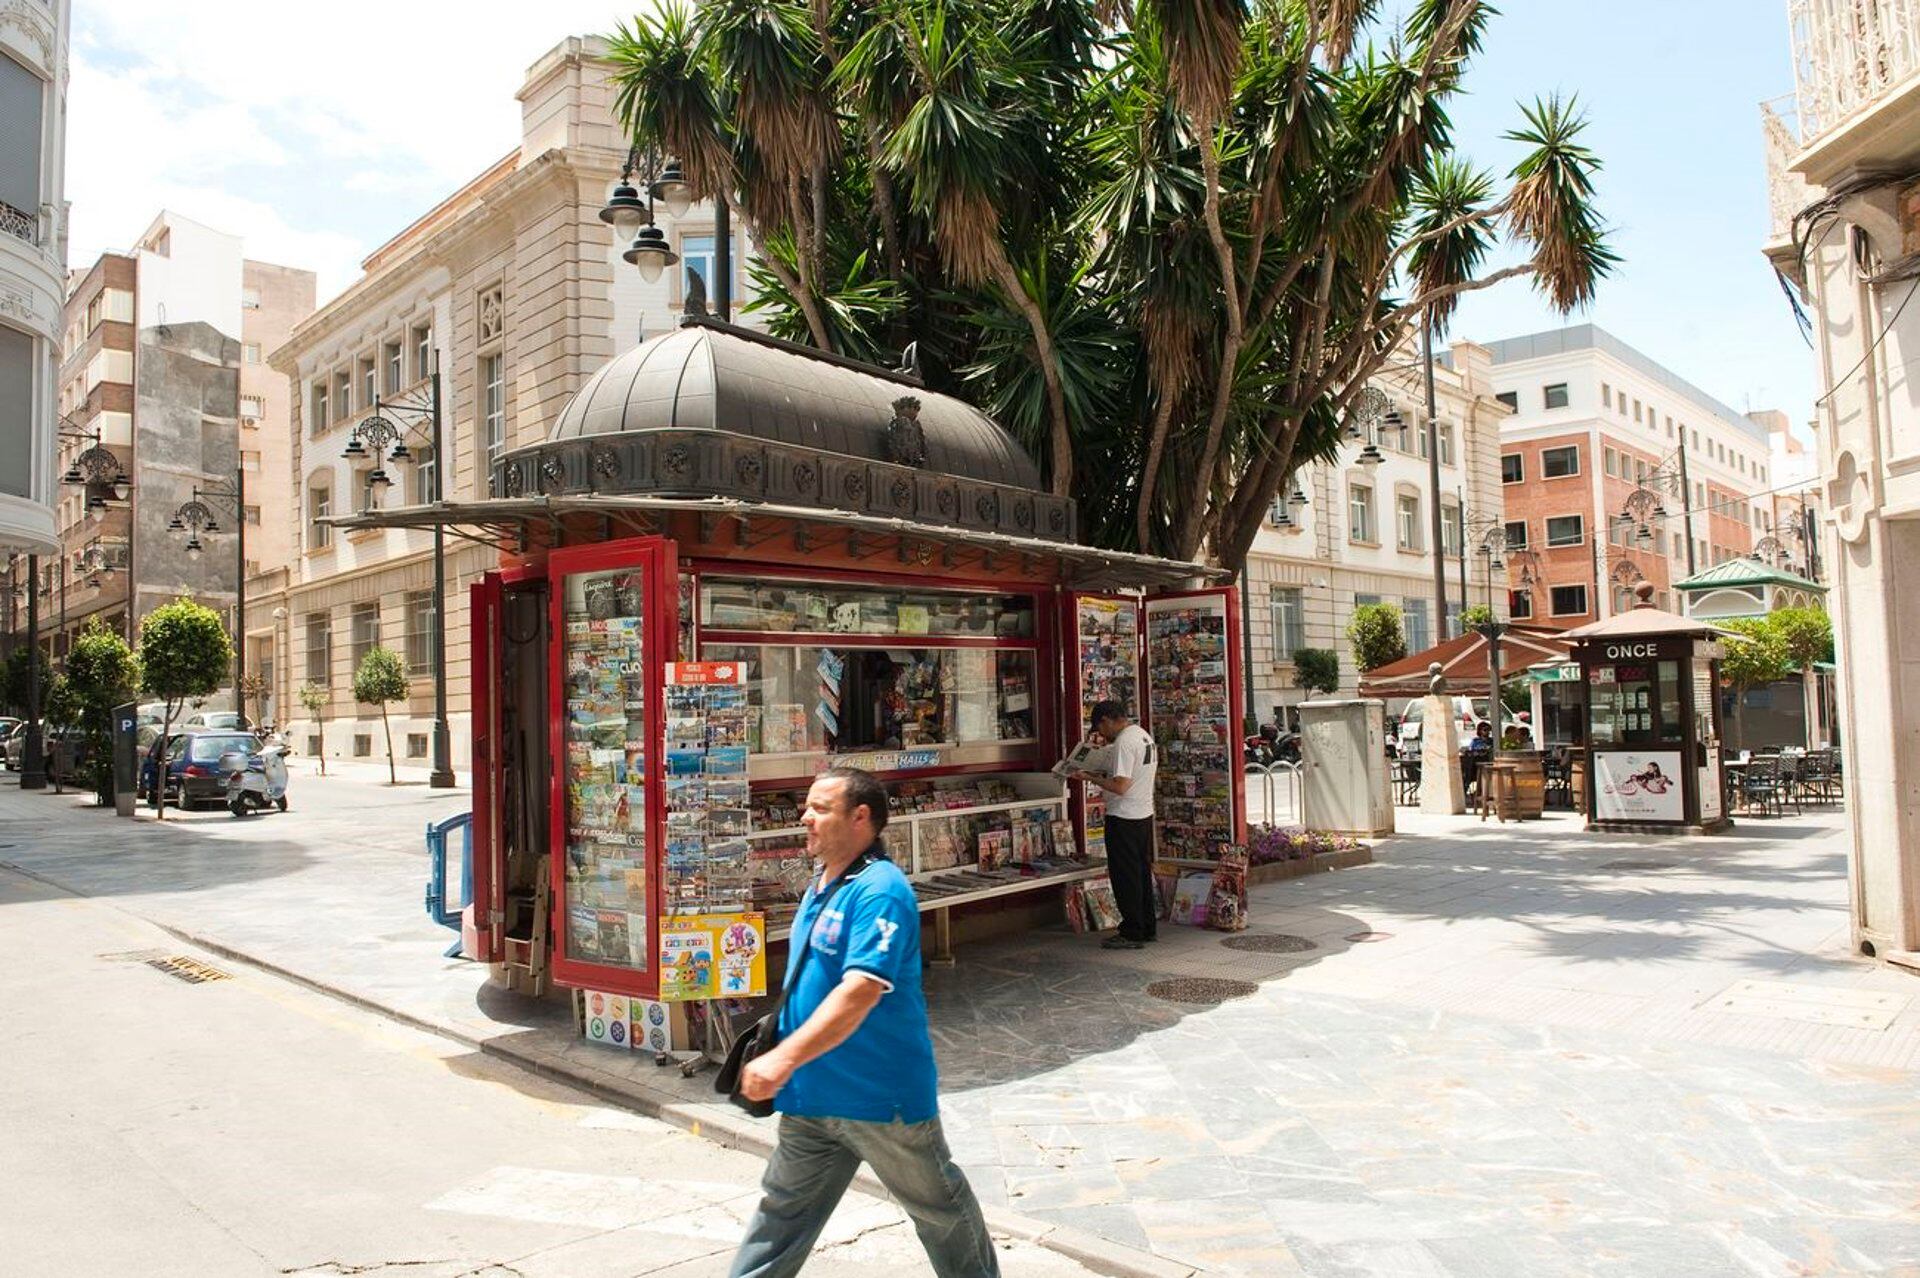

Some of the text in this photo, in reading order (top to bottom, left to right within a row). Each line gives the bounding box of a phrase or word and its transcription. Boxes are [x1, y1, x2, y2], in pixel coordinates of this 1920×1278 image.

[1606, 643, 1658, 659] ONCE
[121, 719, 132, 732] P
[899, 753, 929, 766] HALLS
